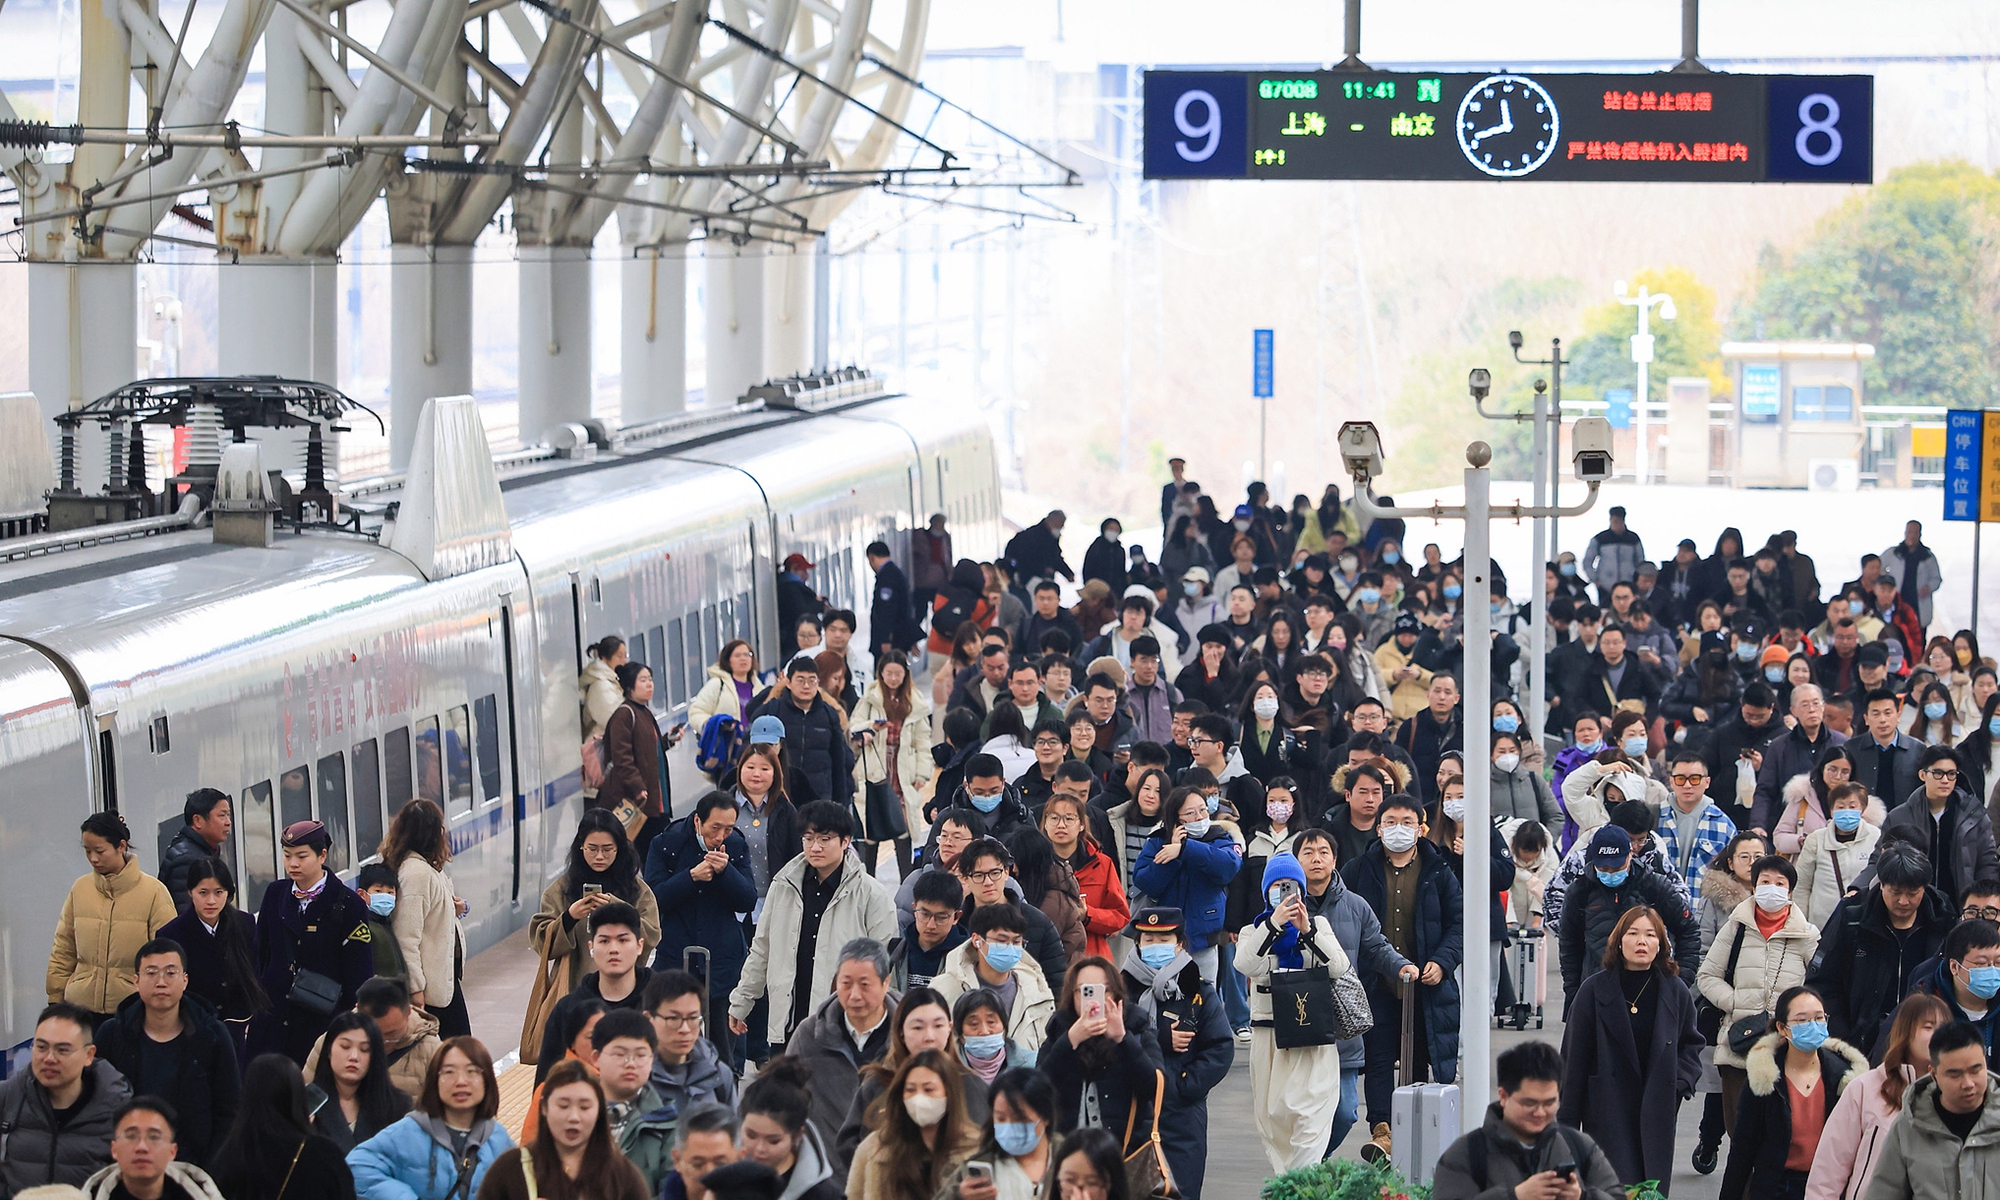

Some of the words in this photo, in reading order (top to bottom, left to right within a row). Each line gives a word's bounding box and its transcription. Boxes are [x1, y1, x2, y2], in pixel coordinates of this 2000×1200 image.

[1343, 81, 1396, 99] 11:41
[1603, 91, 1712, 111] 站台禁止吸烟
[1174, 89, 1221, 162] 9
[1281, 112, 1327, 136] 上海
[1391, 112, 1436, 136] 南京
[1795, 92, 1843, 166] 8
[1952, 416, 1976, 428] CRH
[1953, 433, 1971, 517] 停车位置
